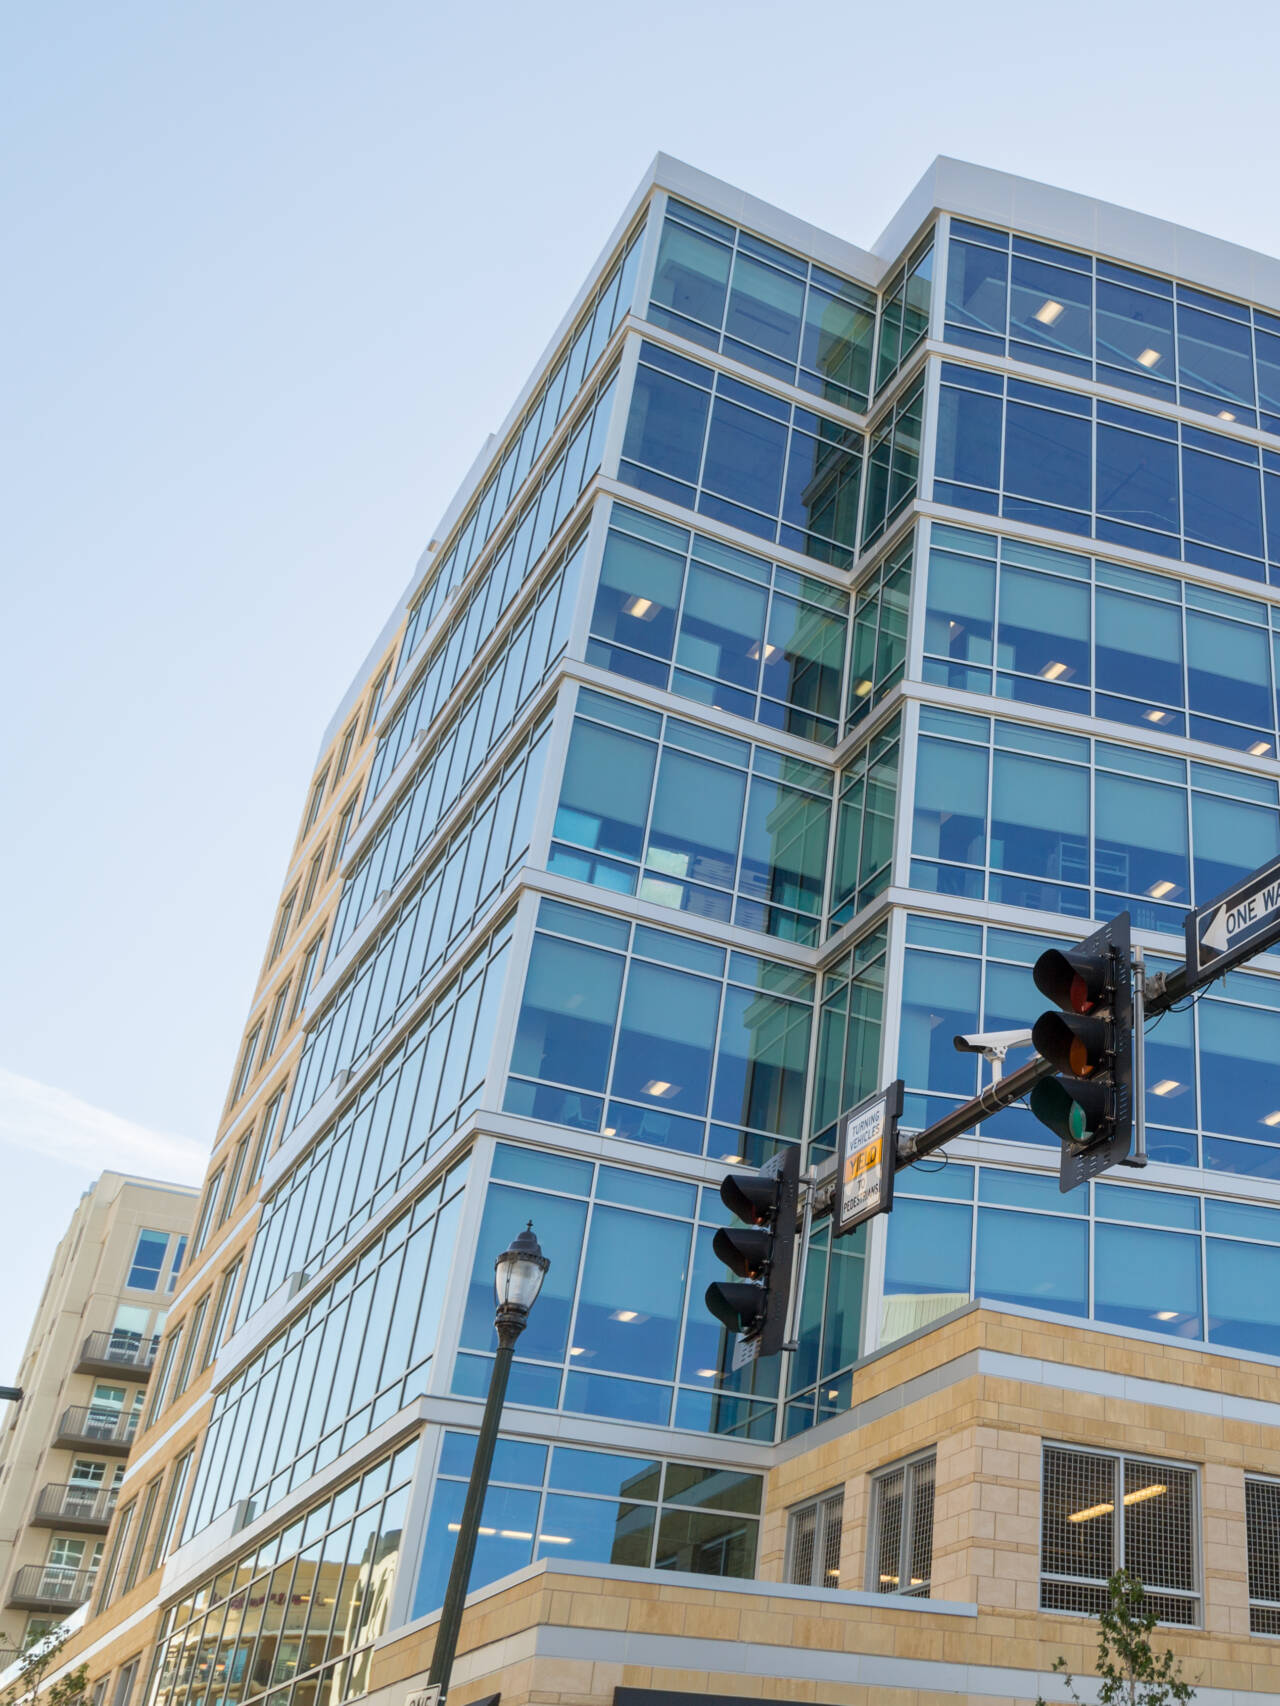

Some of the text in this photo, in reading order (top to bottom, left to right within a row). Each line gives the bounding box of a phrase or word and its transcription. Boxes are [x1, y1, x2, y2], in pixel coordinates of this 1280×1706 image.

[1226, 898, 1258, 935] ONE
[849, 1123, 880, 1151] VEHICLES
[852, 1111, 880, 1137] TURNING
[850, 1145, 877, 1177] YIELD
[843, 1183, 879, 1213] PEDESTRIANS
[857, 1178, 866, 1191] TO
